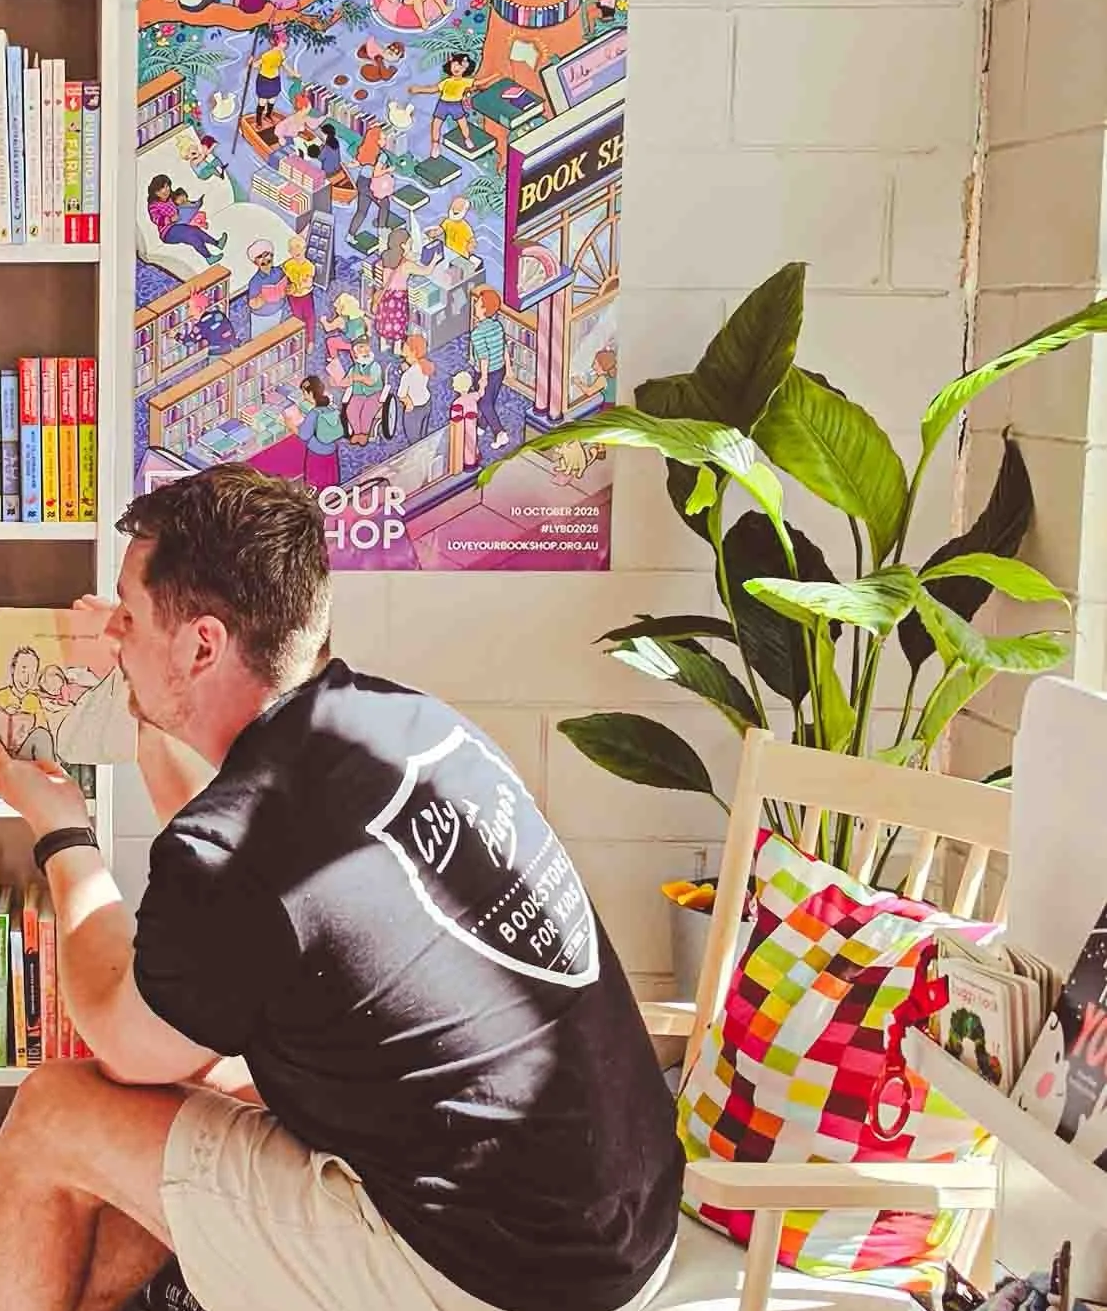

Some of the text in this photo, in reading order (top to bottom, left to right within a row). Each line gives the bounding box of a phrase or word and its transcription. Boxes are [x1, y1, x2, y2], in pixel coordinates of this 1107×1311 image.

[66, 138, 79, 185] FARM
[85, 114, 96, 178] BUILDING
[519, 151, 589, 212] BOOK
[314, 485, 407, 516] OUR
[511, 506, 520, 517] 10
[523, 506, 573, 517] OCTOBER
[324, 519, 406, 549] HOP
[447, 540, 600, 551] LOVEYOURBOOKSHOP.ORG.AU
[411, 799, 462, 874] Lily
[529, 917, 561, 958] FOR
